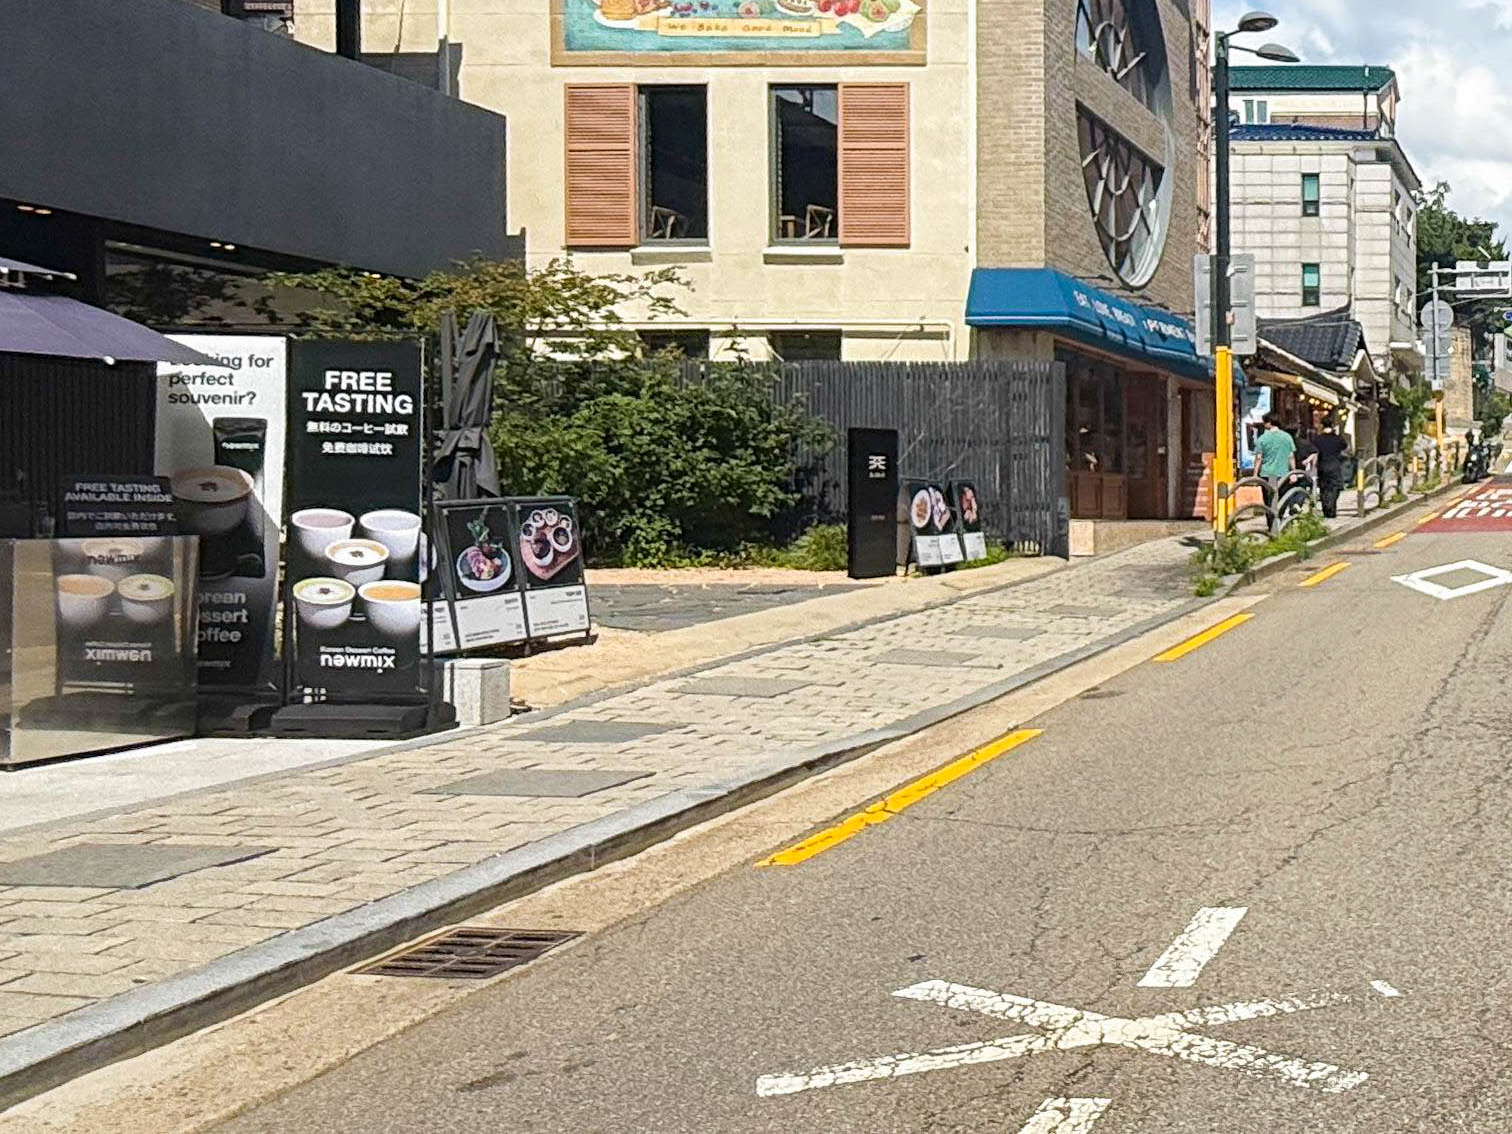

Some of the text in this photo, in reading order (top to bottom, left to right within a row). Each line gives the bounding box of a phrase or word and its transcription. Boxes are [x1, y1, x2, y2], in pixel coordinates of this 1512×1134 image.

[248, 353, 275, 368] for
[169, 371, 234, 387] perfect
[325, 370, 393, 391] FREE
[168, 391, 257, 405] souvenir?
[302, 392, 414, 414] TASTING
[75, 482, 161, 494] FREE TASTING
